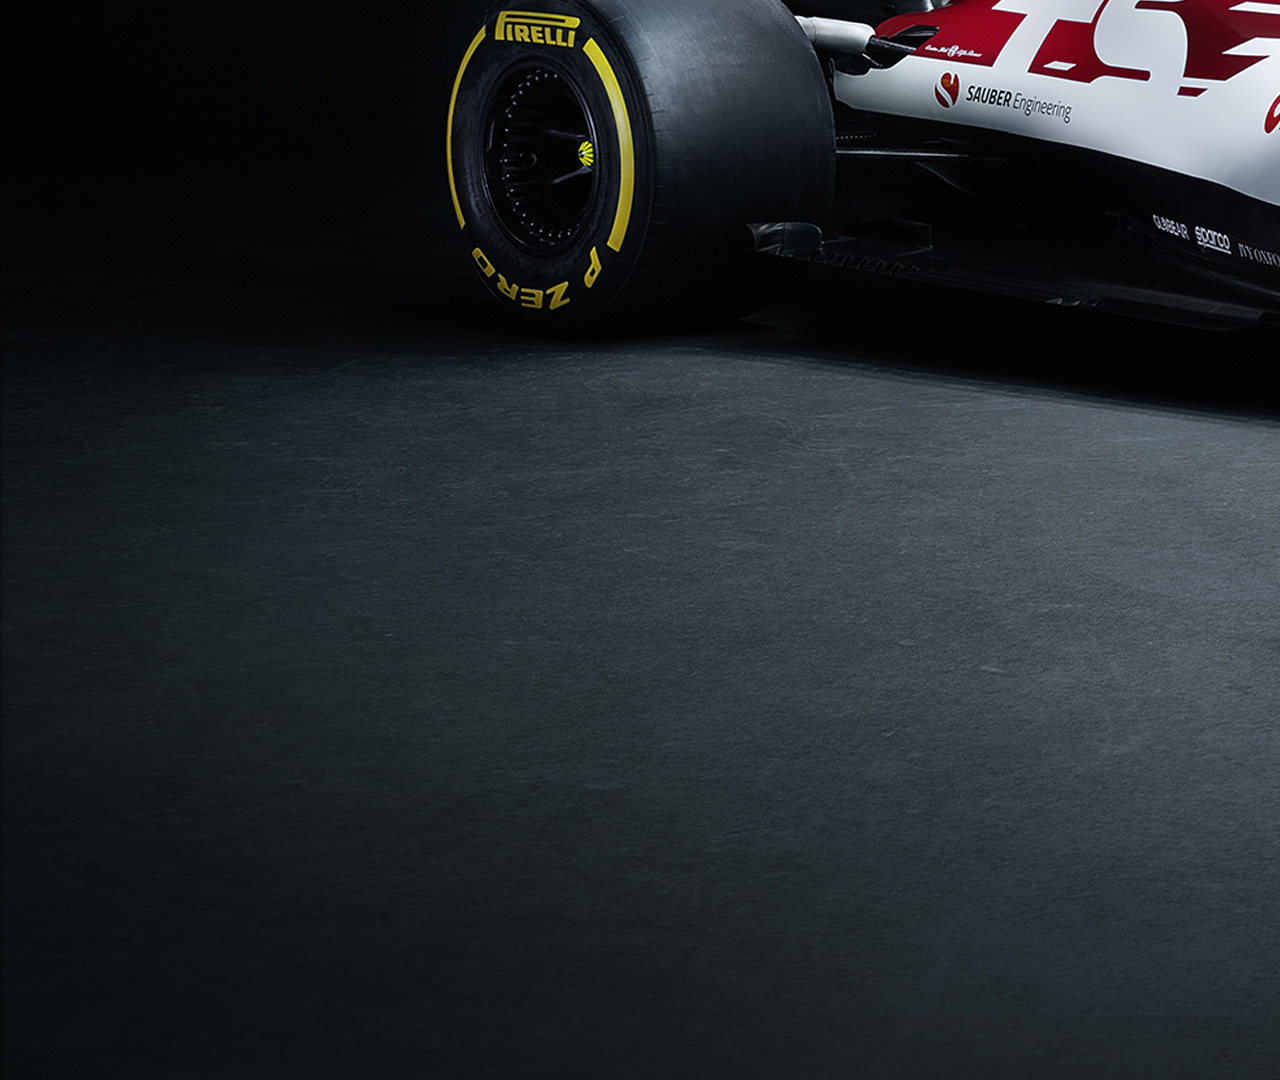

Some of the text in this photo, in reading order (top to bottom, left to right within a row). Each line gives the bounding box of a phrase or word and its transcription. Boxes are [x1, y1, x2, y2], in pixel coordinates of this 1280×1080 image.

[494, 10, 580, 48] PIRELLI
[965, 85, 1073, 124] SAUBER Engineering
[1194, 225, 1231, 252] sparco
[471, 246, 603, 311] P ZERO
